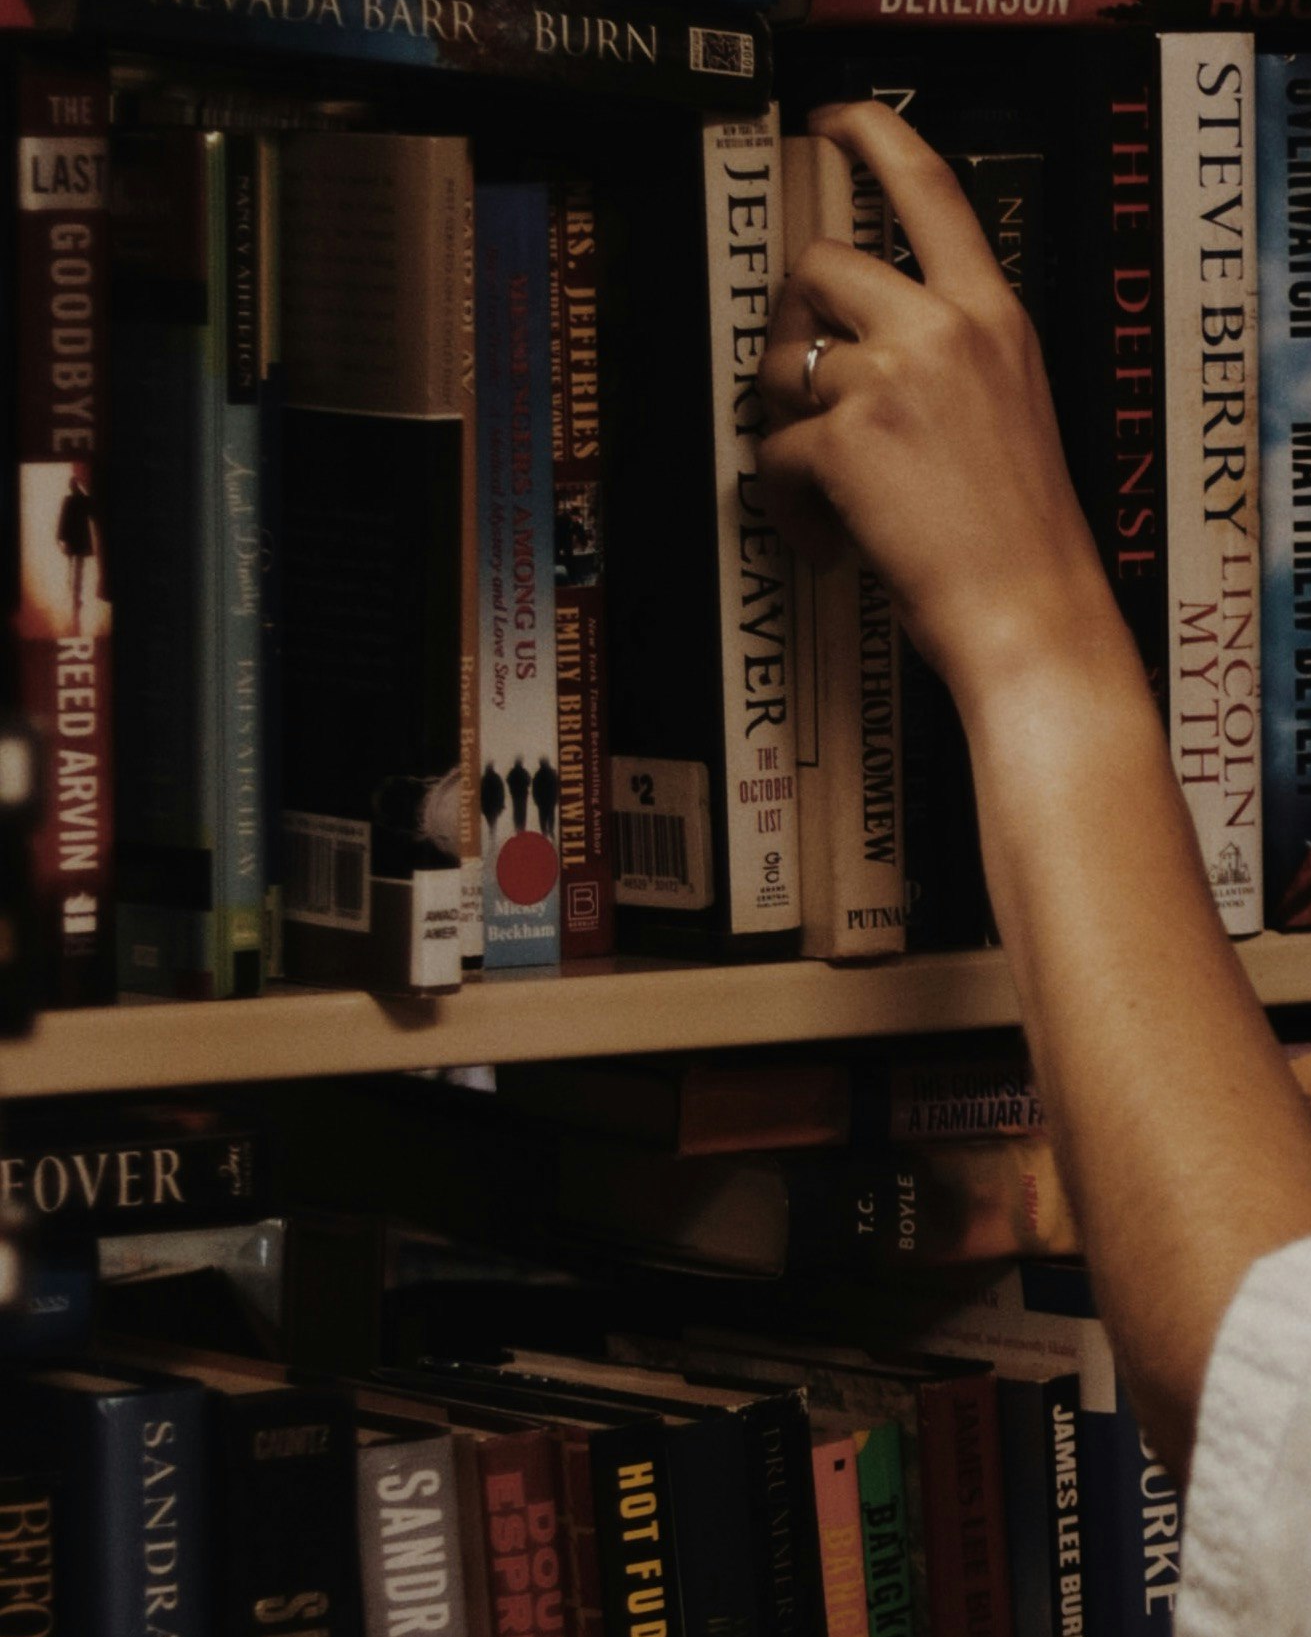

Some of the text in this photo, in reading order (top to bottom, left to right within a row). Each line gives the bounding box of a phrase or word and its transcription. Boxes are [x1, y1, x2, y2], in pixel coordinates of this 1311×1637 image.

[533, 10, 658, 65] BURN
[31, 153, 105, 196] LAST
[49, 223, 96, 454] GOODBYE
[1196, 61, 1253, 537] STEVE BERRY
[1179, 601, 1221, 788] MYTH
[1221, 554, 1256, 830] LINCOLN
[55, 636, 99, 872] REED ARVIN
[629, 772, 655, 805] $2
[738, 774, 794, 805] OCTOBER
[756, 806, 783, 834] LIST
[487, 921, 557, 943] Beckham
[896, 1172, 917, 1252] BOYLE
[1051, 1402, 1081, 1511] JAMES
[613, 1460, 657, 1543] HOT
[1055, 1515, 1082, 1569] LEE
